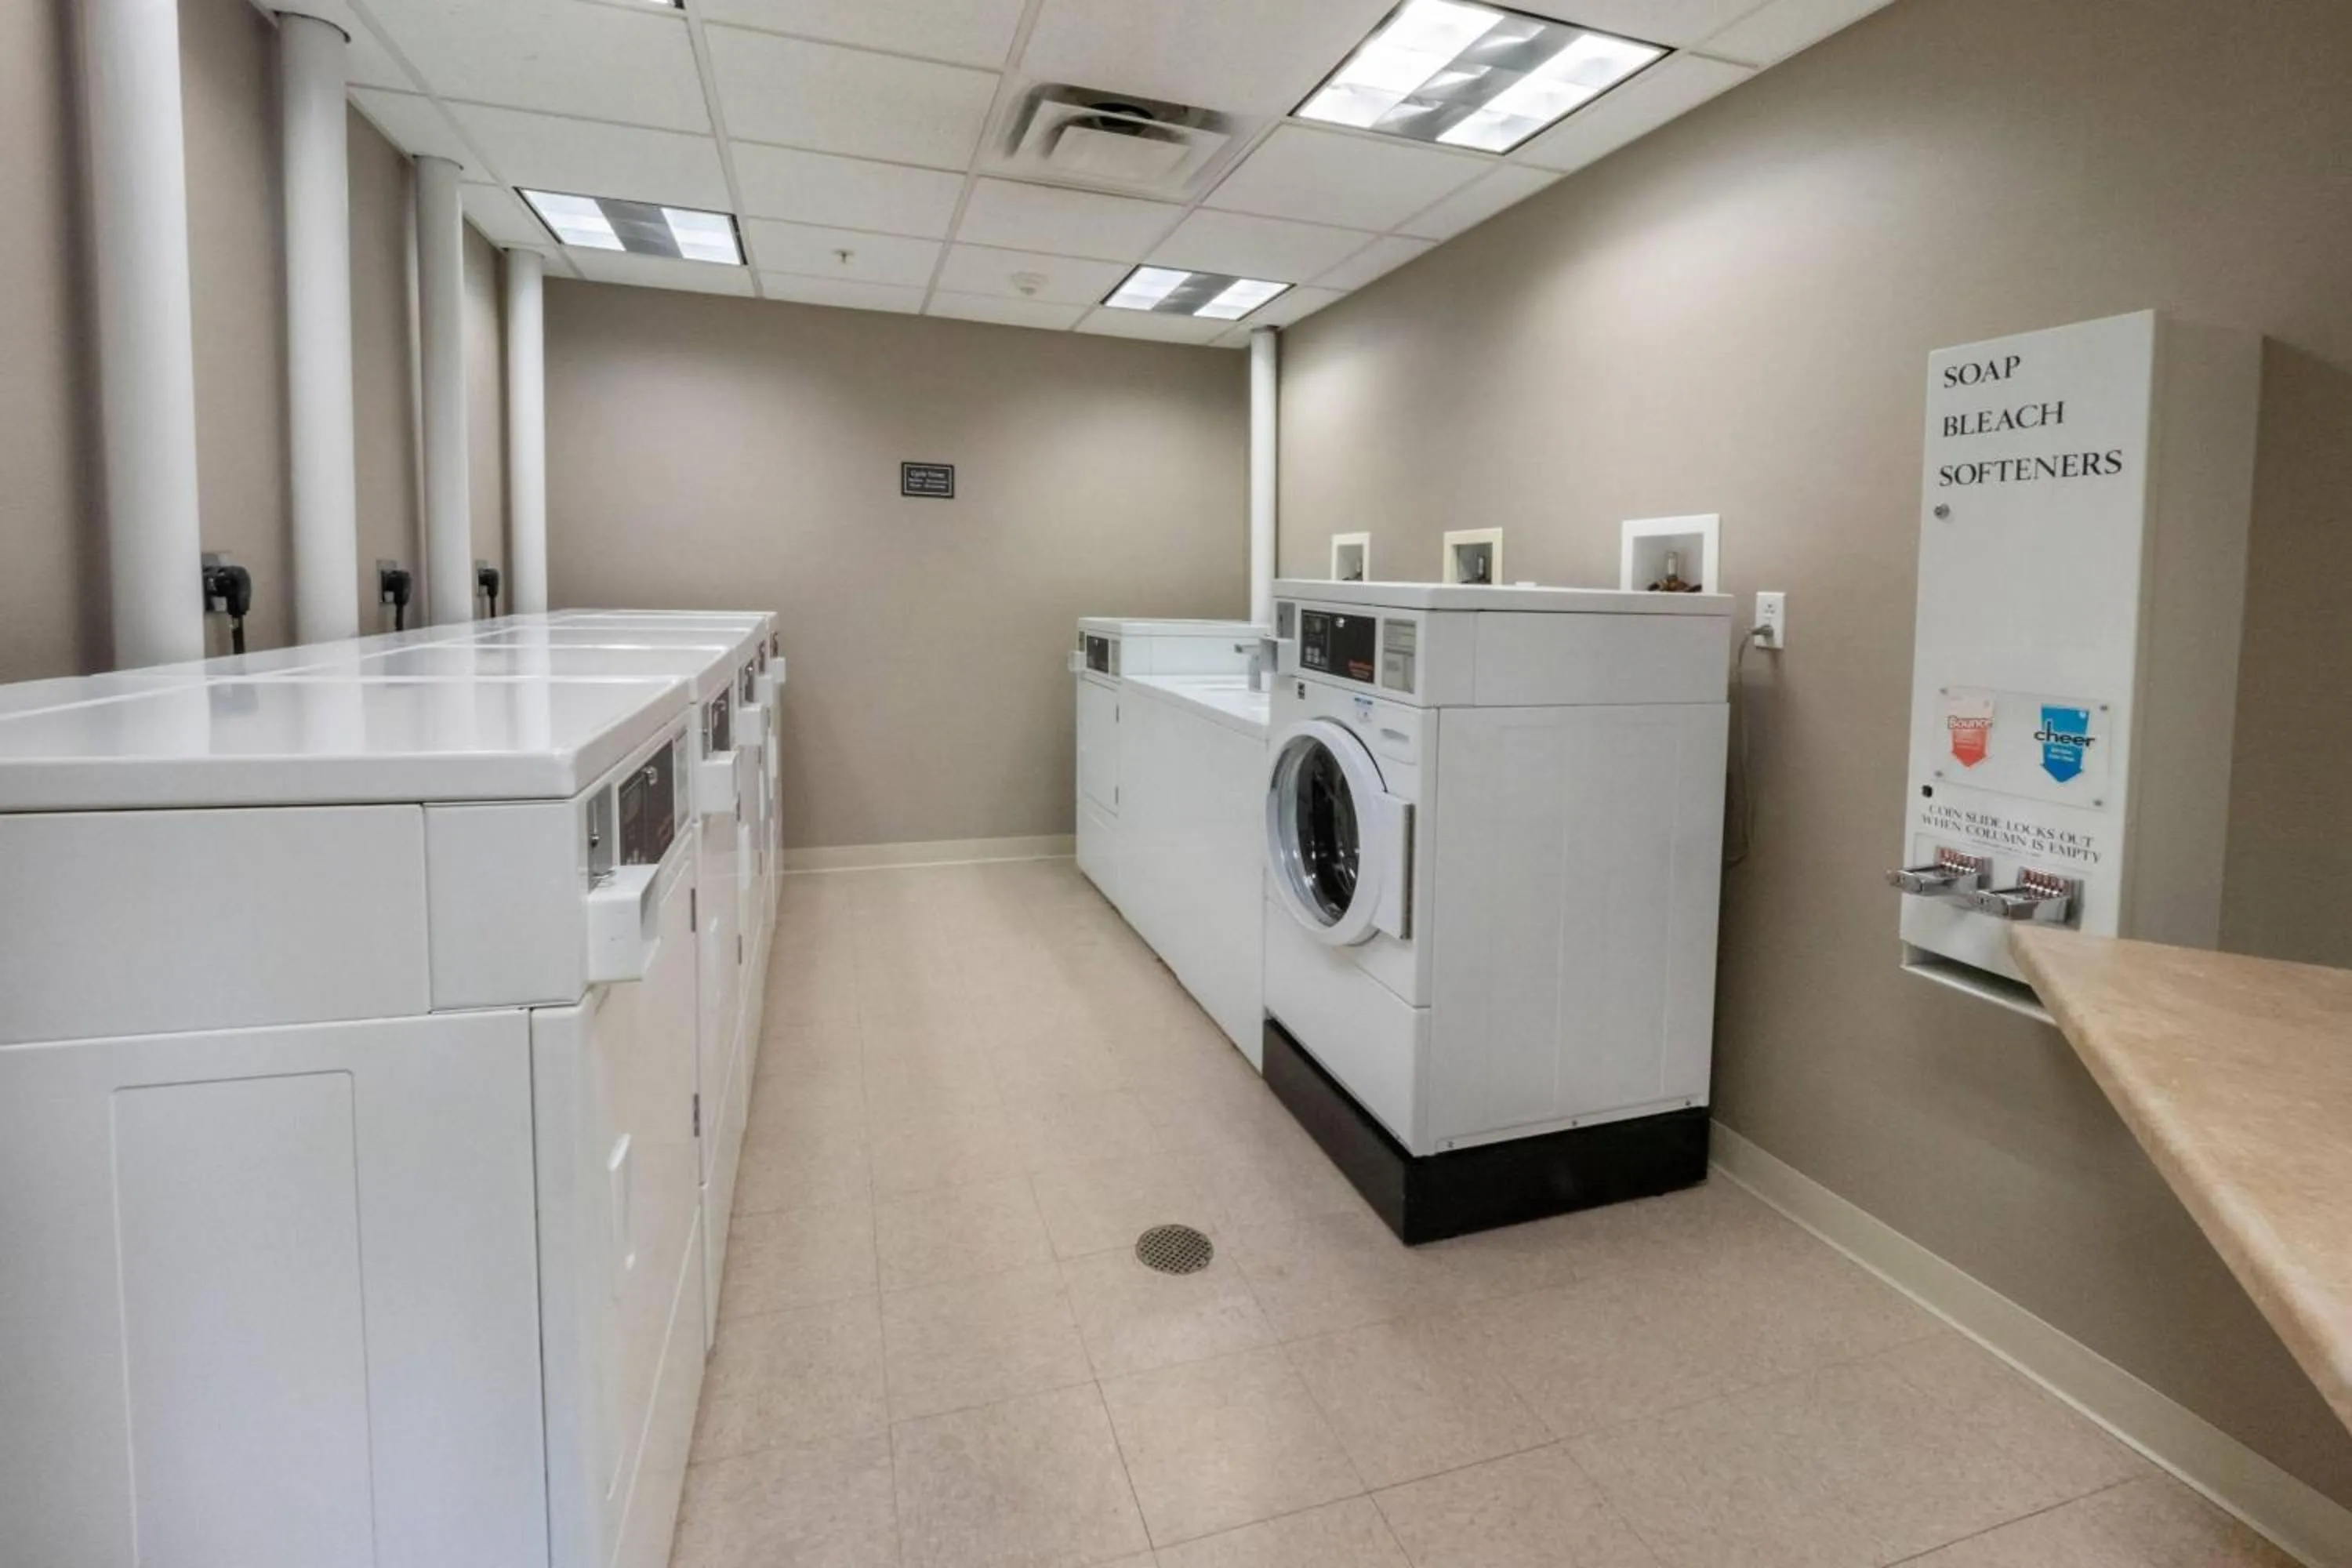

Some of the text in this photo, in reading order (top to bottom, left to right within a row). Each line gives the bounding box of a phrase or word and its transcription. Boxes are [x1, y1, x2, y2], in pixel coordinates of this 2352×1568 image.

[1943, 355, 2021, 389] SOAP
[1943, 401, 2065, 437] BLEACH
[1939, 449, 2123, 487] SOFTENERS
[2034, 720, 2096, 747] cheer
[1922, 815, 1961, 833] WHEN
[1965, 823, 2027, 847] COLUMN
[2032, 839, 2045, 852] IS
[2049, 844, 2103, 864] EMPTY
[1929, 804, 1962, 820] COIN
[1965, 811, 2000, 829] SLIDE
[2006, 818, 2055, 840] LOCKS
[2059, 831, 2094, 848] OUT
